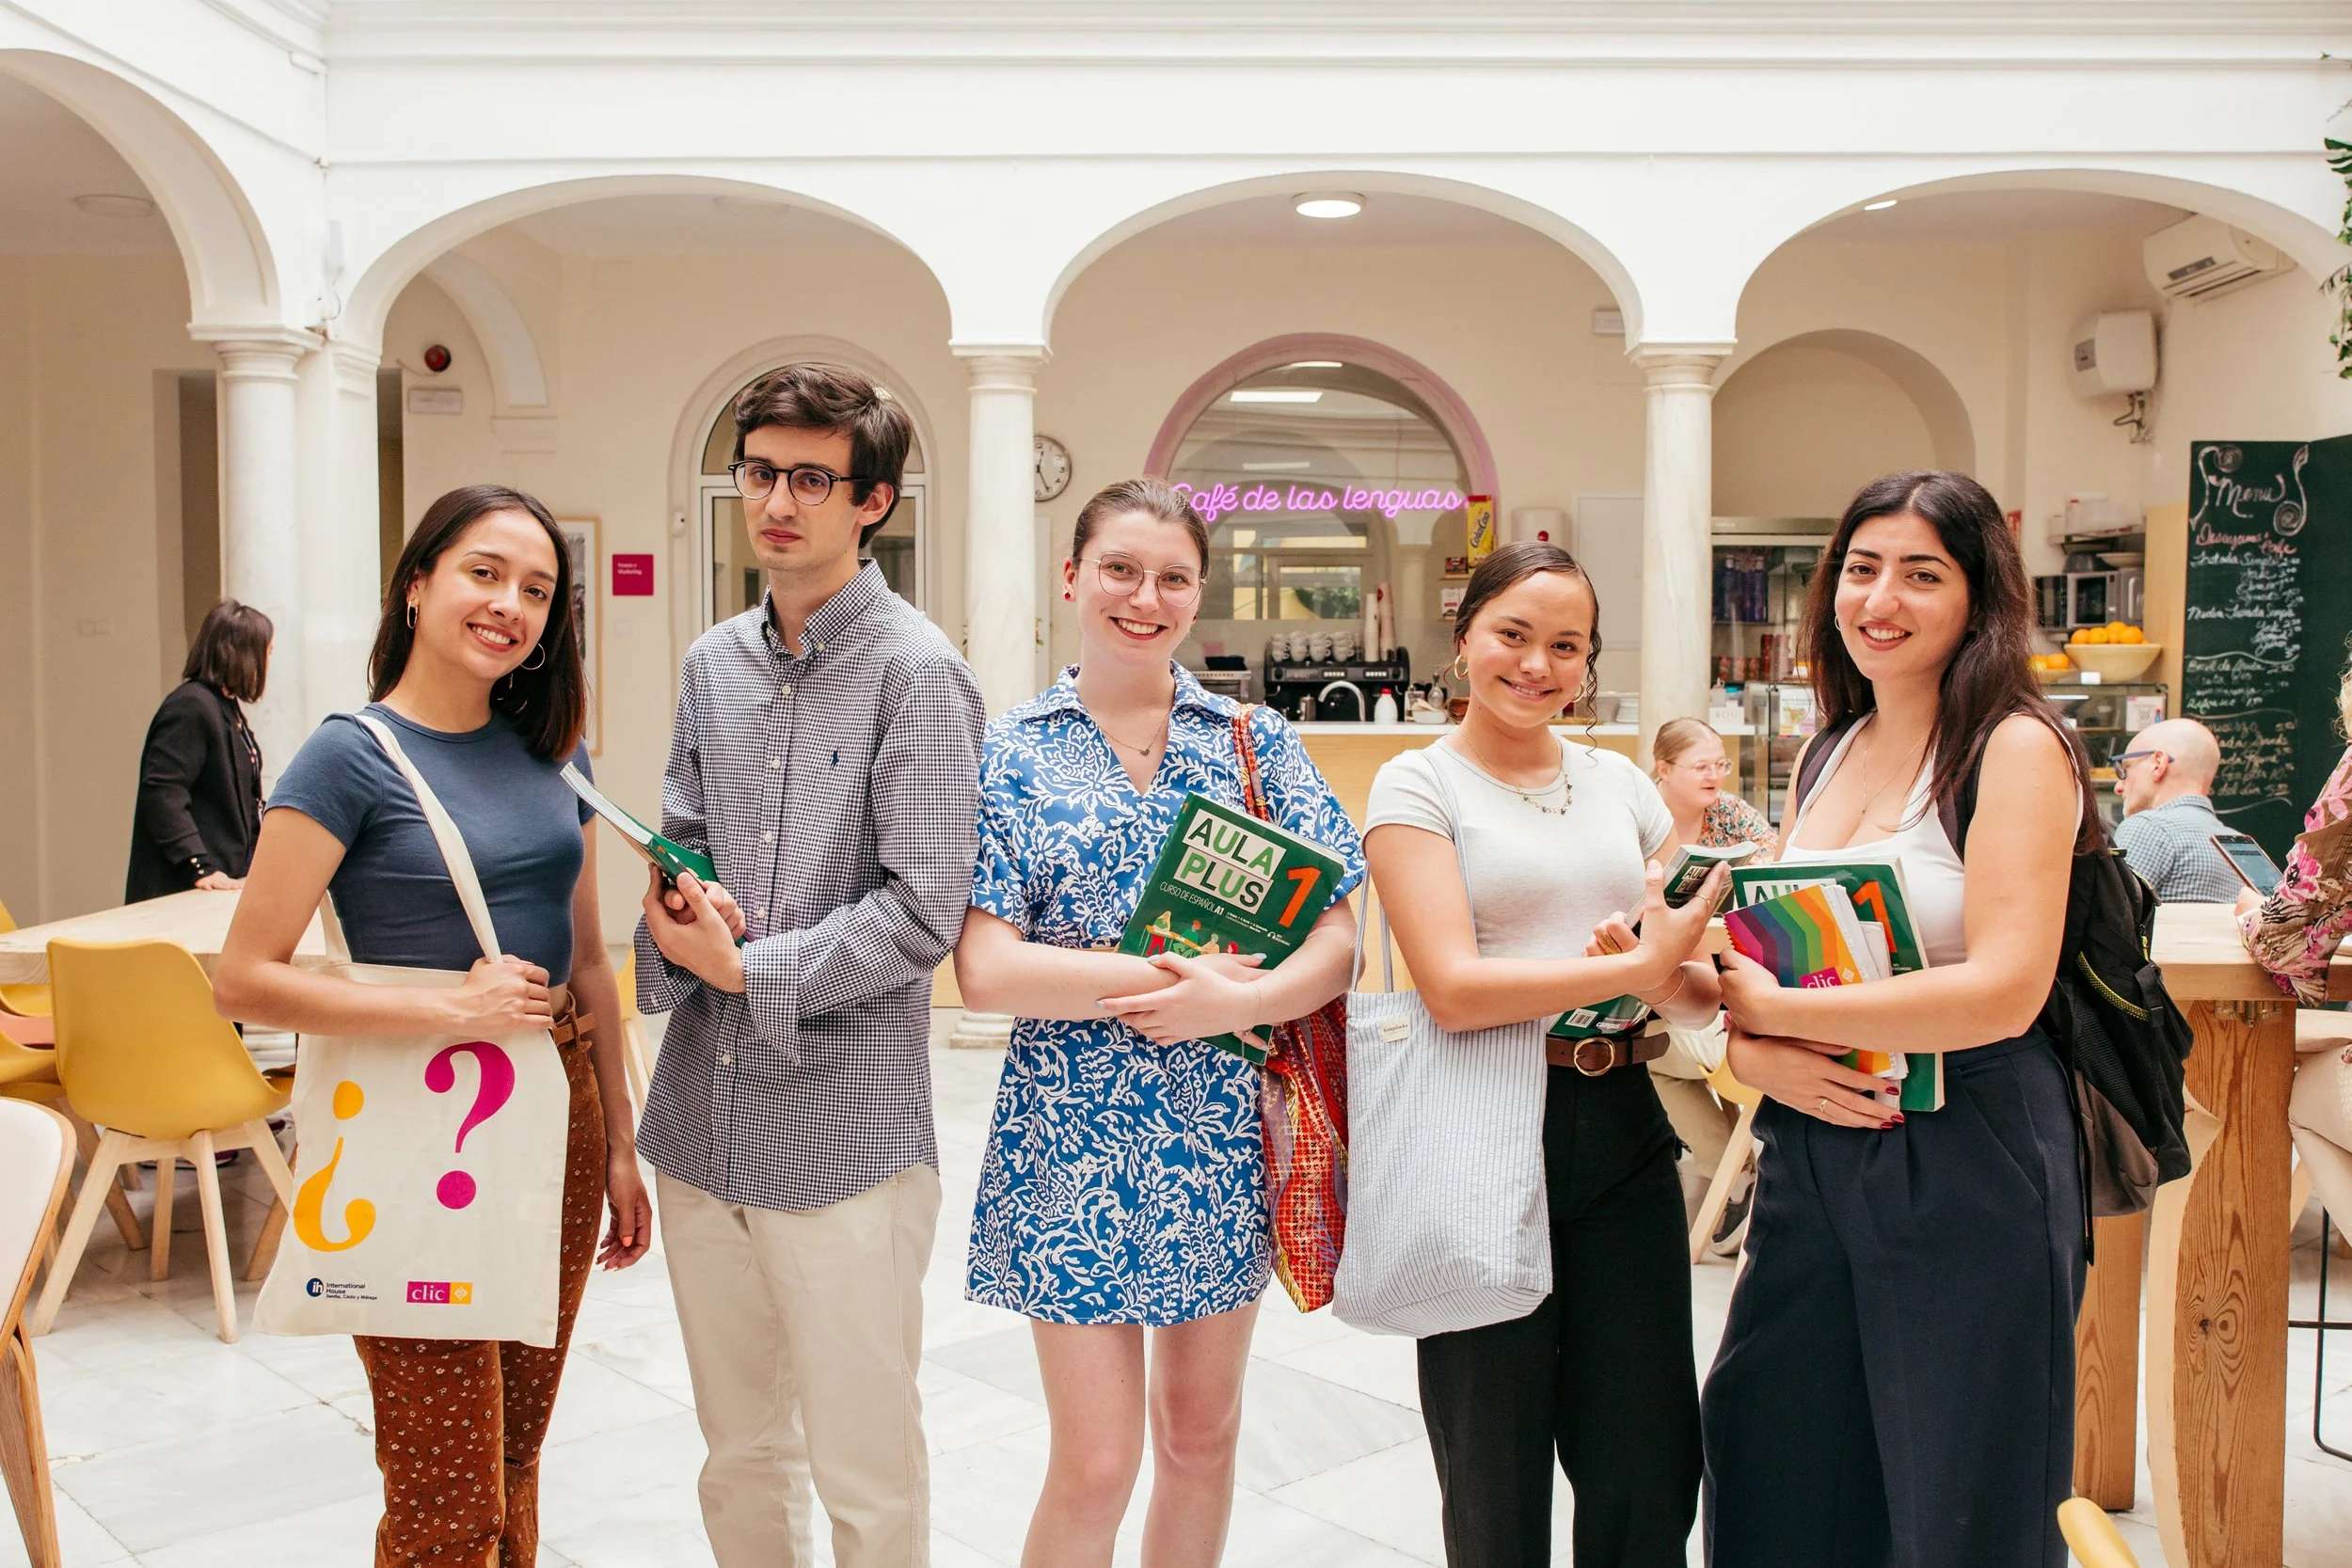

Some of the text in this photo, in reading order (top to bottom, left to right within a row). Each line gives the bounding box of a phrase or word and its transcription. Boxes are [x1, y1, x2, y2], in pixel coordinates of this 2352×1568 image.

[1242, 484, 1281, 511] de
[1286, 485, 1338, 511] las
[1343, 485, 1463, 518] lenguas
[1182, 802, 1188, 814] 1
[1188, 817, 1275, 876] AULA
[1180, 852, 1264, 908] PLUS
[1278, 865, 1322, 928] 1
[1159, 881, 1225, 916] CURSO DE ESPAÑOL A1
[1852, 880, 1898, 953] 1
[1596, 1022, 1621, 1030] campus
[312, 1281, 324, 1293] ih
[411, 1285, 446, 1302] clic
